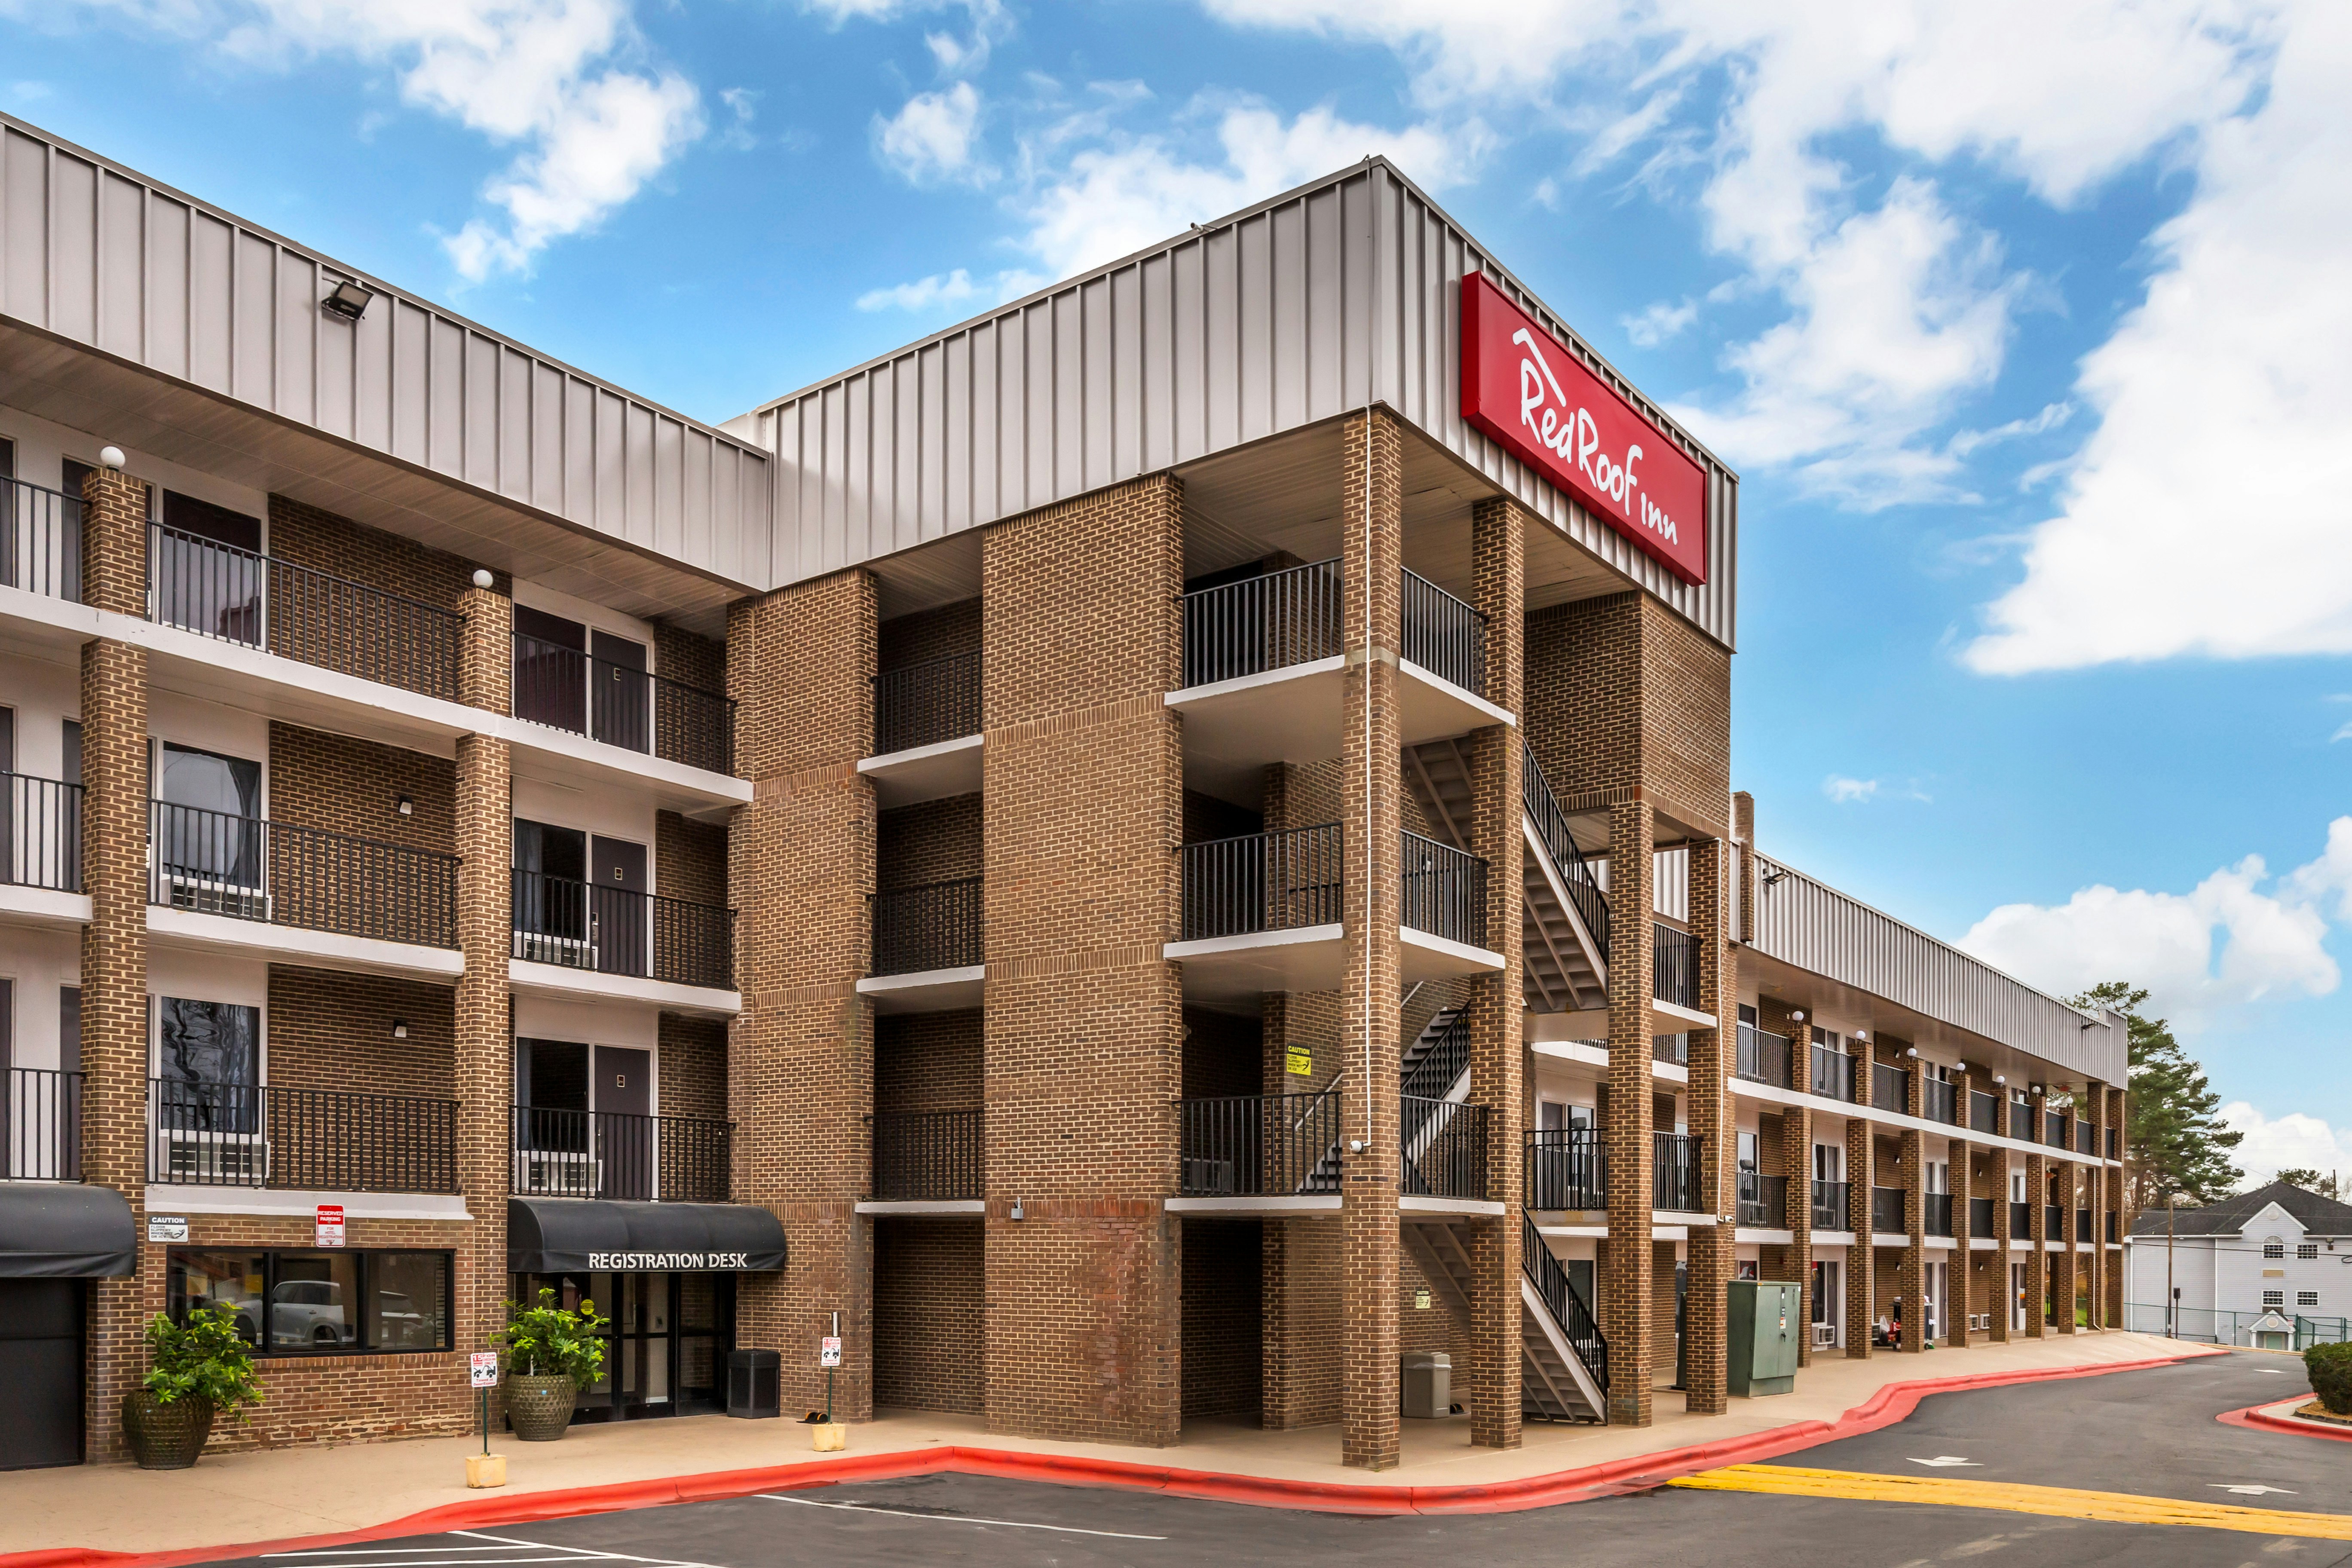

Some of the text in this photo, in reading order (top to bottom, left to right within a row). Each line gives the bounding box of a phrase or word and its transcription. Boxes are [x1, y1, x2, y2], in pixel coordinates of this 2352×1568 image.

[1288, 1045, 1310, 1055] CAUTION
[588, 1253, 748, 1269] REGISTRATION DESK
